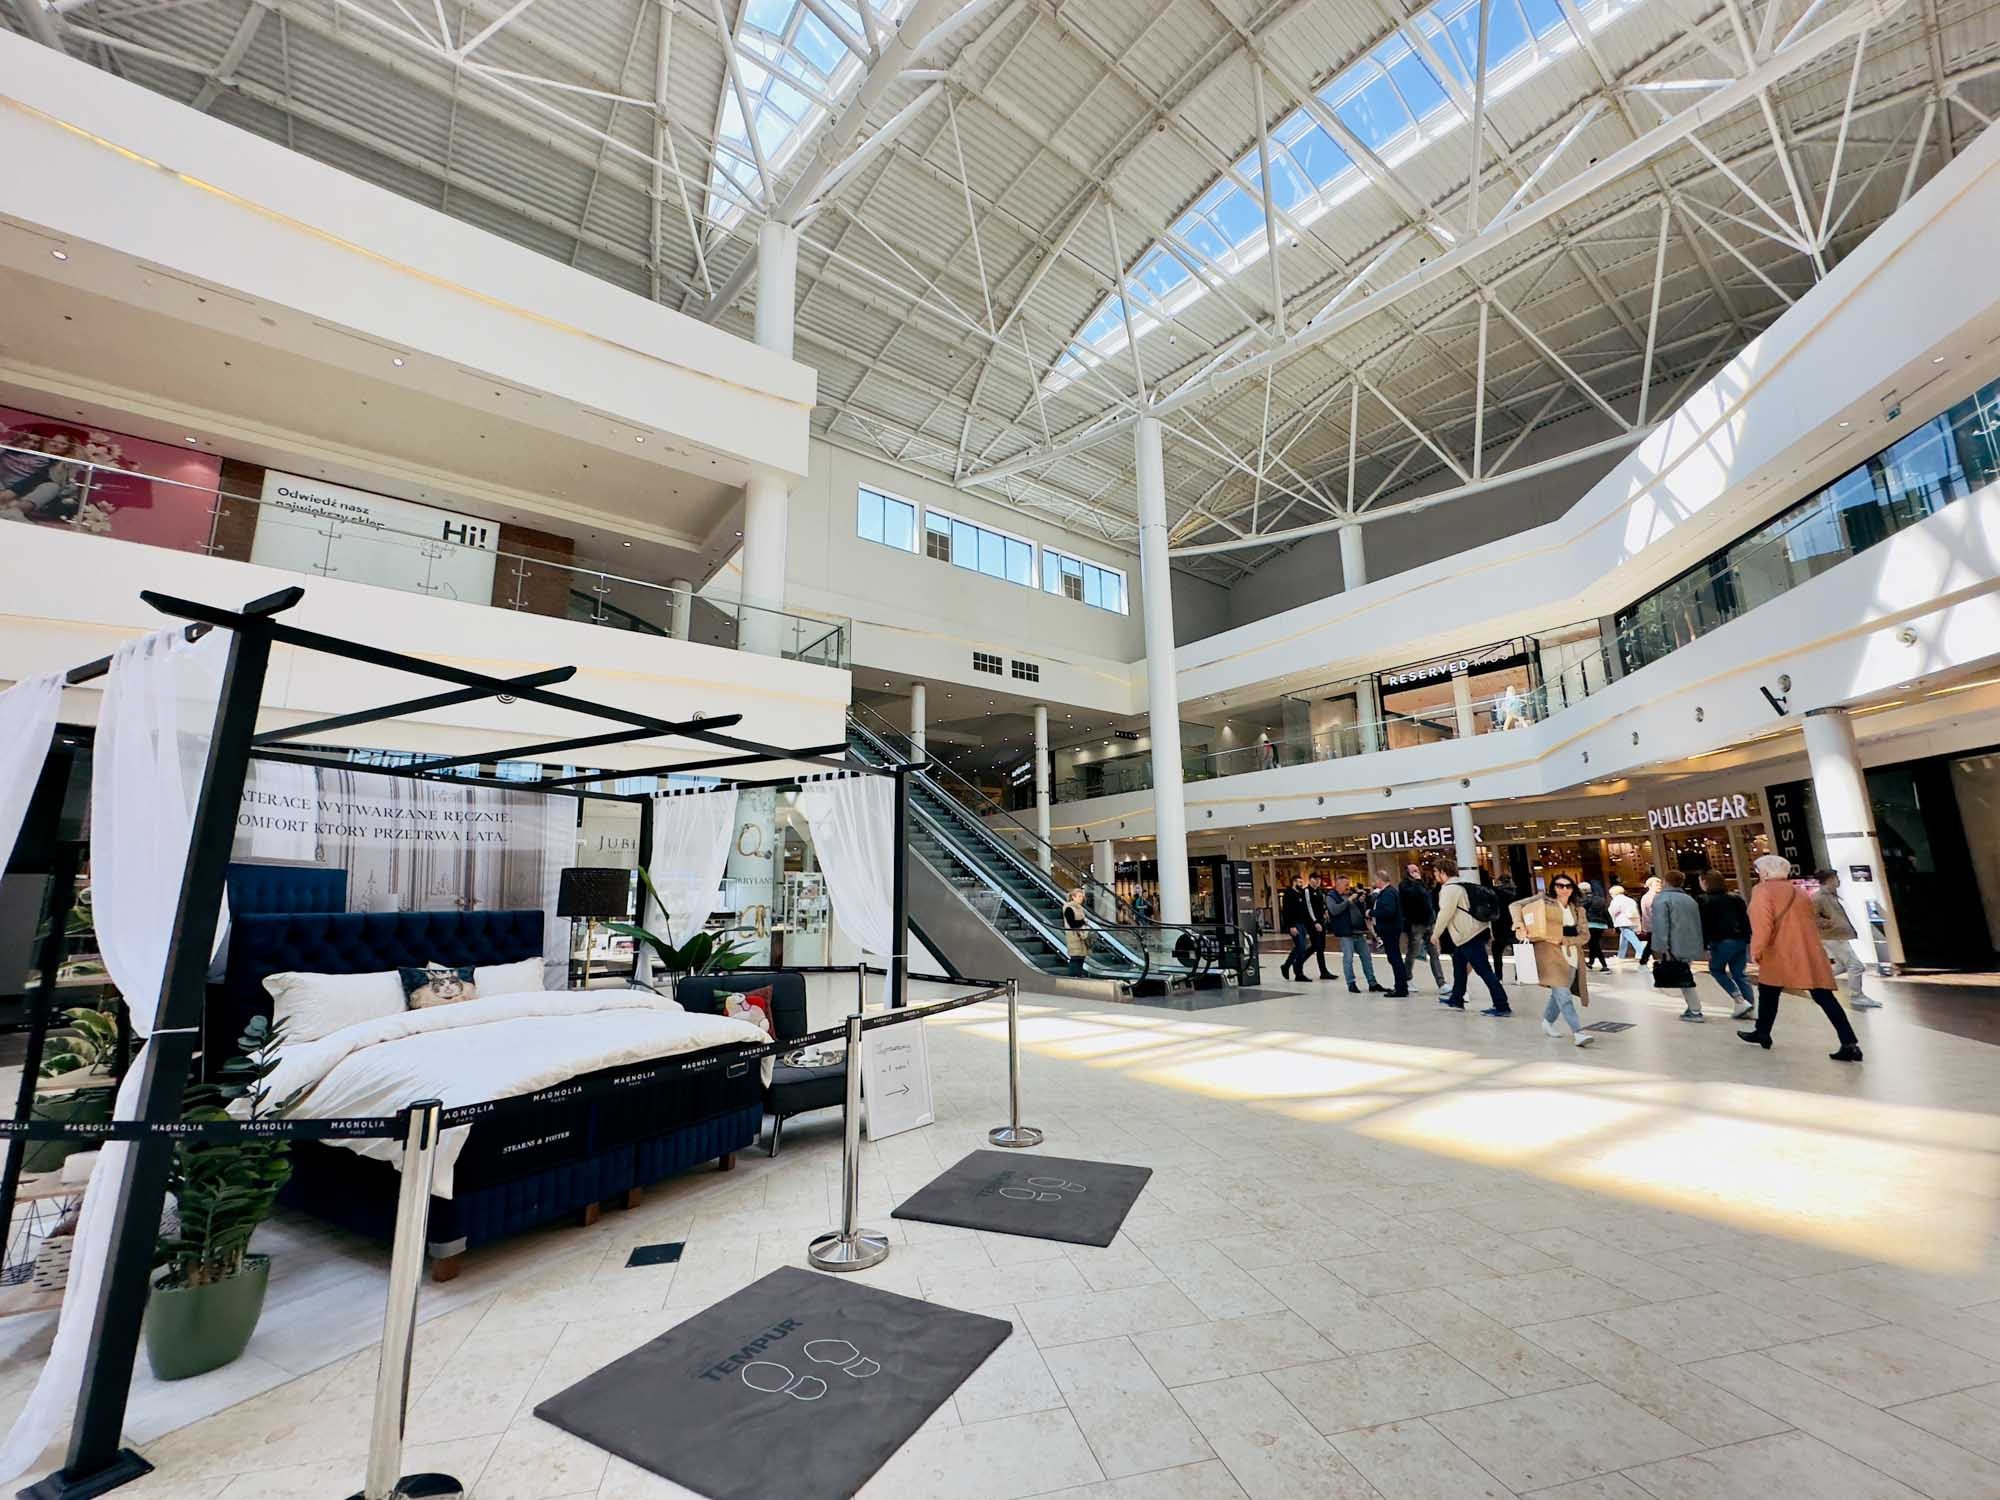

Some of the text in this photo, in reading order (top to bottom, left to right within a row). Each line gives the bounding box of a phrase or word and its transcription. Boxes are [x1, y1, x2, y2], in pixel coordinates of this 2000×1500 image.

[340, 503, 369, 515] nasz
[442, 520, 487, 549] Hi!
[1389, 659, 1469, 686] RESERVED
[317, 800, 438, 821] WYTWARZANE
[1648, 794, 1749, 831] PULL&BEAR
[238, 814, 308, 833] OMFORT
[374, 827, 460, 842] PRZETRWA
[1371, 825, 1483, 850] PULL&BER
[739, 1045, 771, 1057] MAGNOLIA
[681, 1057, 718, 1070] MAGNOLIA
[613, 1071, 656, 1085] MAGNOLIA
[533, 1086, 583, 1102] MAGNOLIA
[444, 1103, 494, 1120] AGNOLIA
[64, 1123, 116, 1132] MAGNOLIA
[151, 1123, 204, 1132] MAGNOLIA
[240, 1122, 294, 1132] MAGNOLIA
[331, 1120, 385, 1130] MAGNOLIA
[502, 1140, 535, 1155] STEARNS
[699, 1318, 804, 1381] TEMPUR
